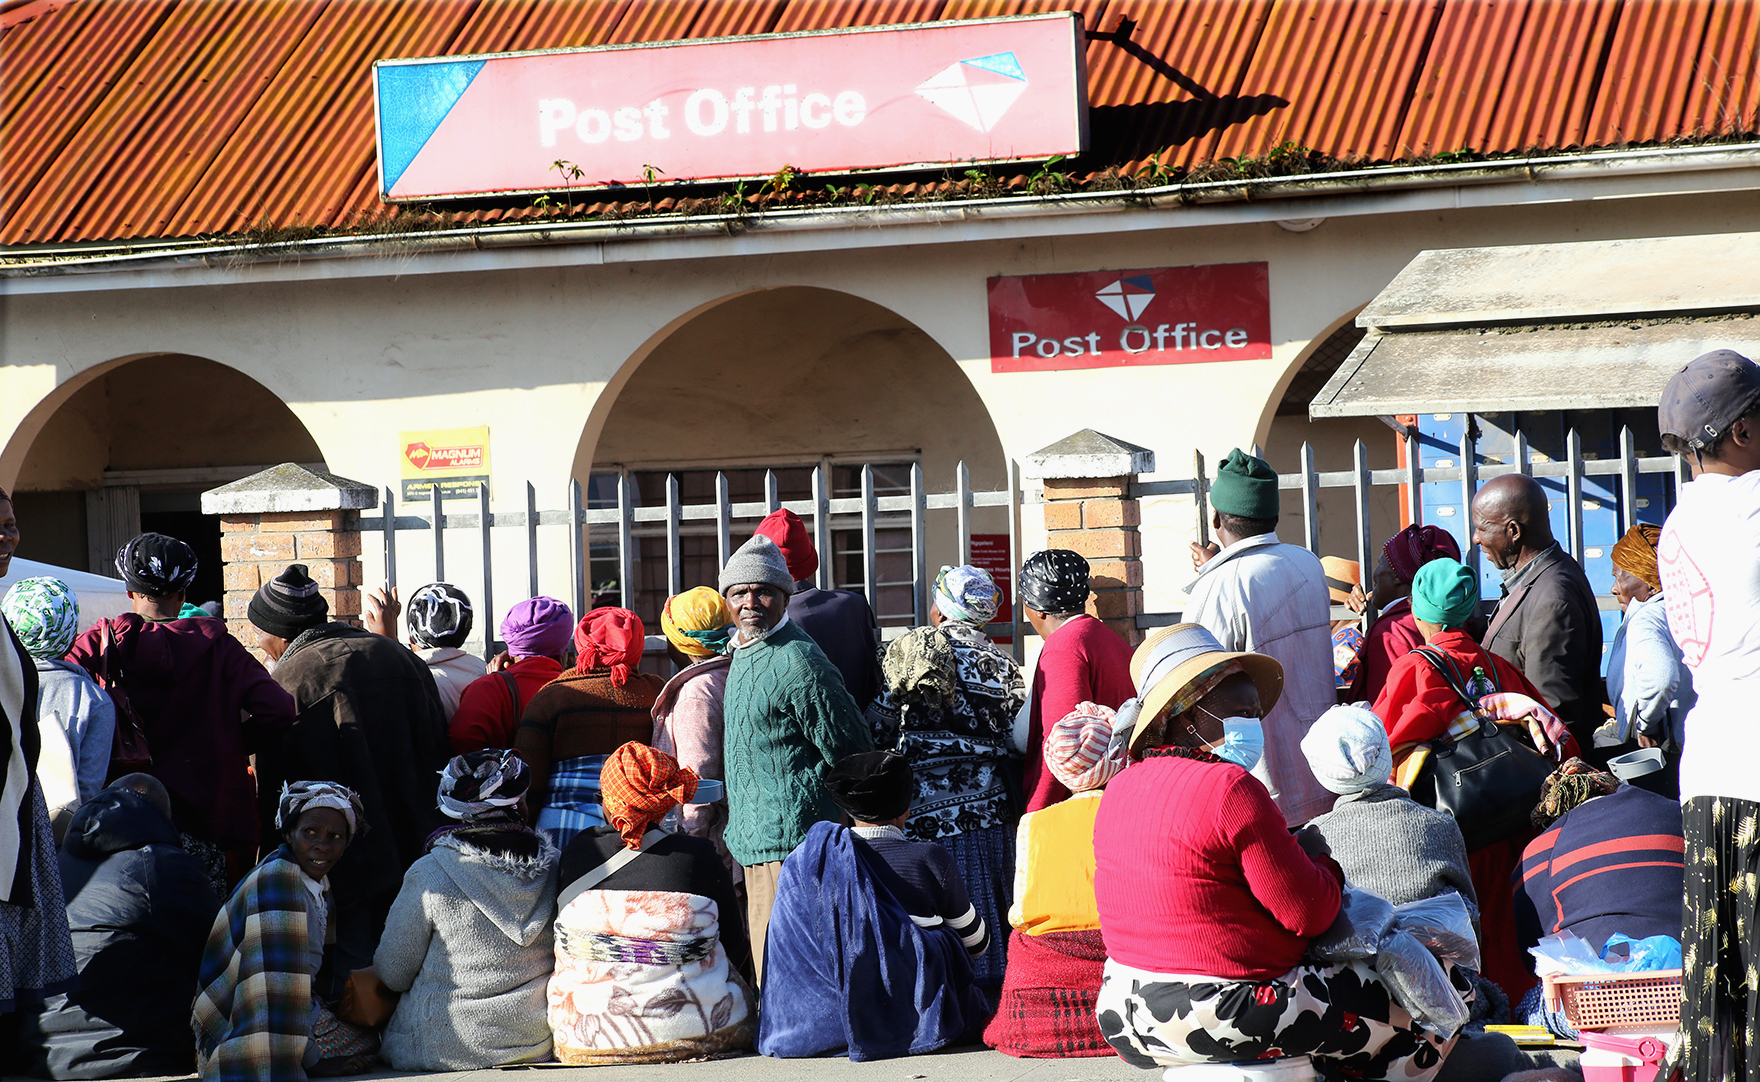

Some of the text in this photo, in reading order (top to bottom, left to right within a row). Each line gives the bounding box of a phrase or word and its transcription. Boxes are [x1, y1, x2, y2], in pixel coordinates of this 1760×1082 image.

[538, 84, 866, 147] Post Office
[1011, 322, 1249, 359] Post Office
[431, 449, 480, 460] MAGNUM
[450, 458, 480, 466] ALARMS
